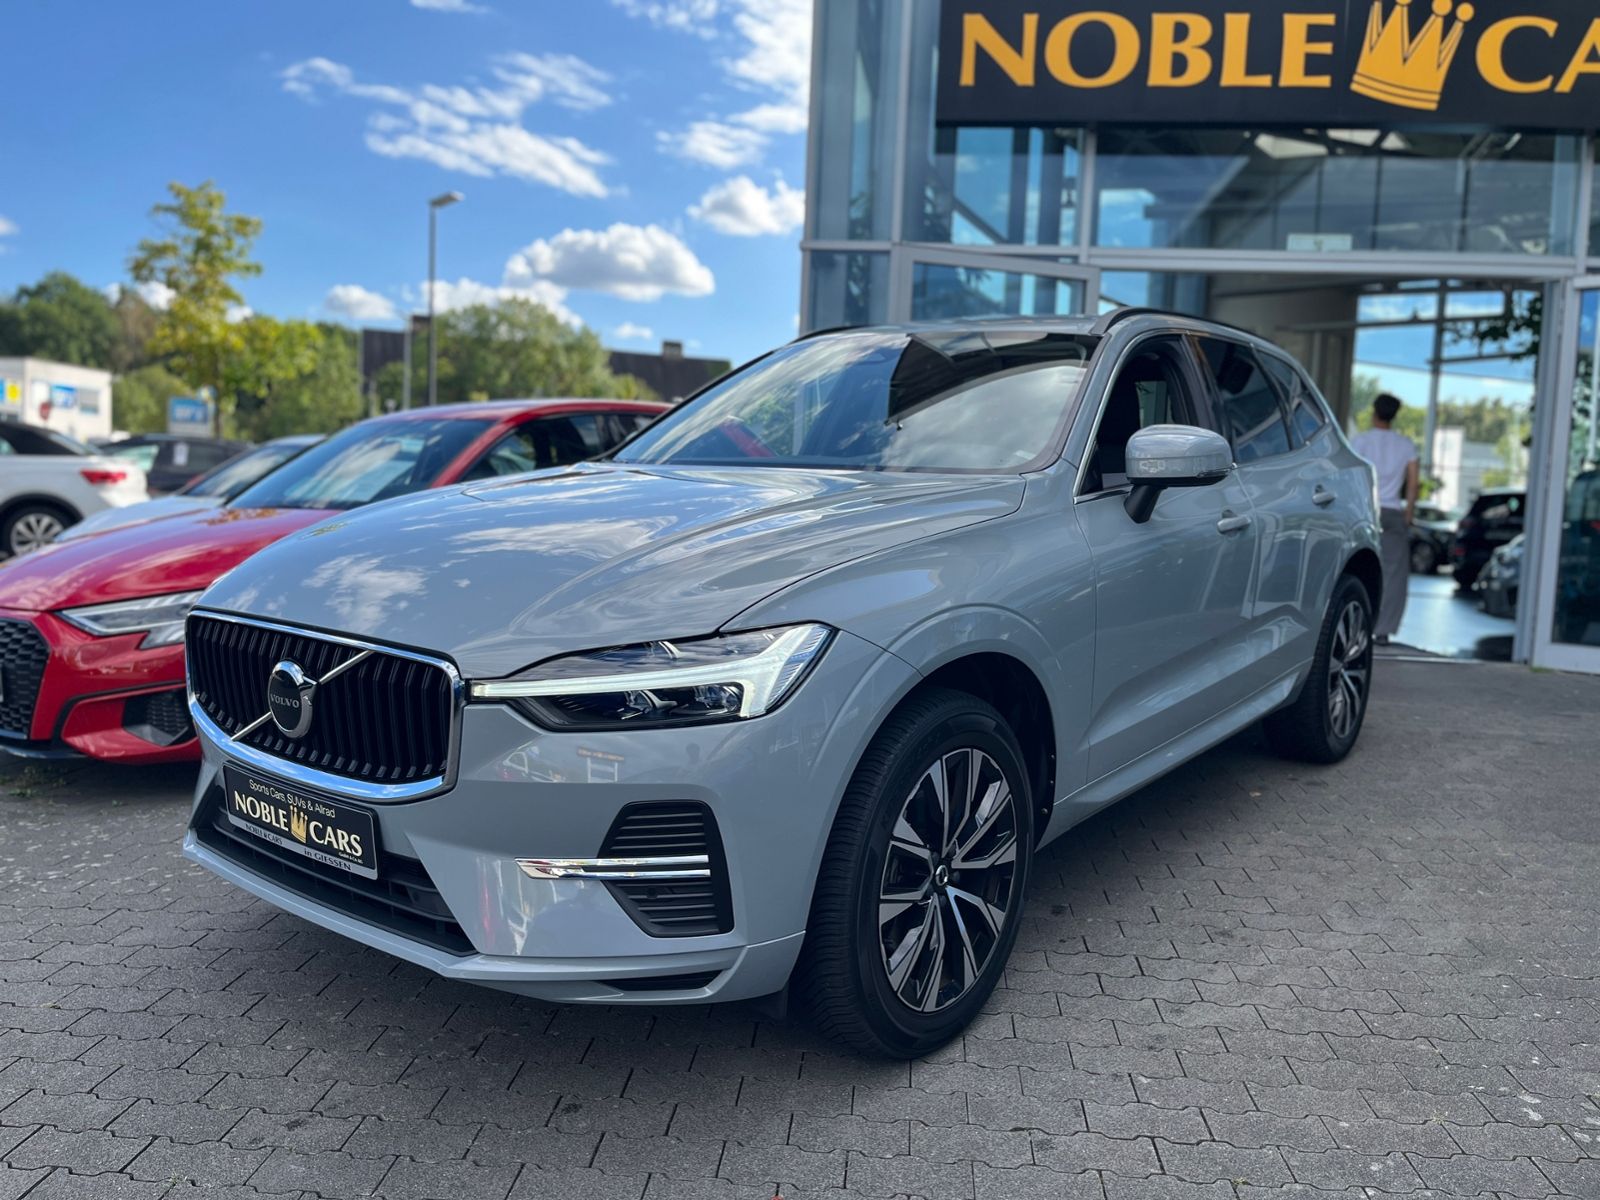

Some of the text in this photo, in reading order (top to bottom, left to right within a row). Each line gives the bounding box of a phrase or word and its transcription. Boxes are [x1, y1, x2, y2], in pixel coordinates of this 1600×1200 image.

[961, 12, 1337, 88] NOBLE
[270, 694, 300, 708] VOLVO
[249, 779, 270, 796] Sports
[287, 794, 307, 809] SUVs
[307, 800, 314, 811] &
[315, 803, 336, 818] Allrad
[234, 790, 363, 857] NOBLE CARS
[304, 848, 312, 856] in
[314, 852, 352, 871] GIESSEN
